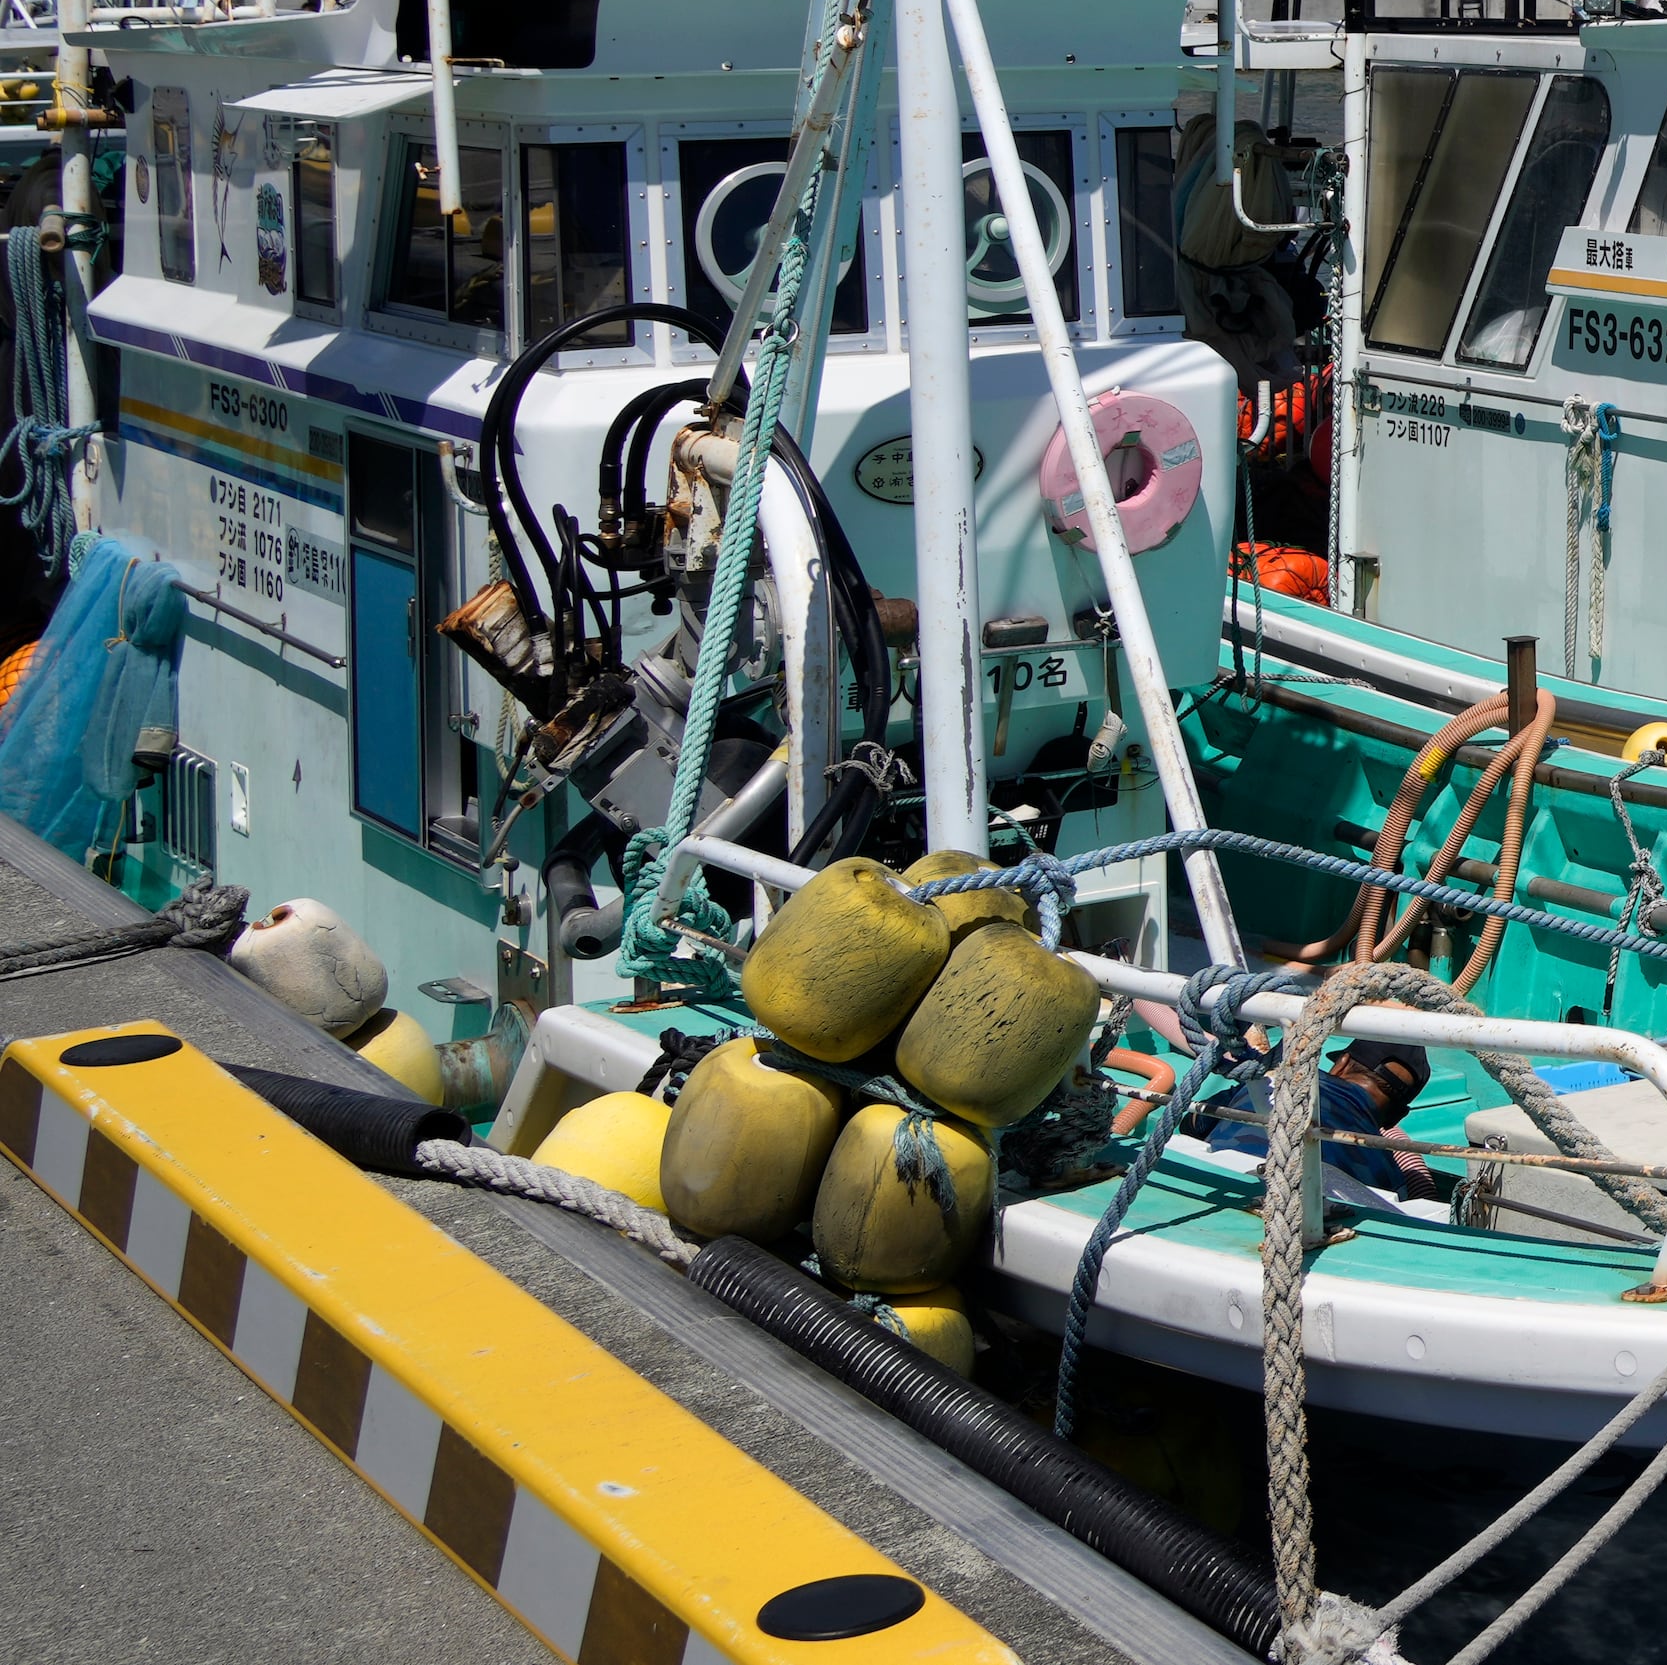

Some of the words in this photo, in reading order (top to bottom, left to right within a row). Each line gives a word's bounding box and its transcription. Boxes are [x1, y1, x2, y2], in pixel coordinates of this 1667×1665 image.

[210, 382, 288, 432] FS3-6300
[218, 479, 246, 516] フシ自
[253, 491, 281, 528] 2171
[254, 529, 283, 566] 1076
[254, 566, 283, 603] 1160
[987, 656, 1068, 694] 10名
